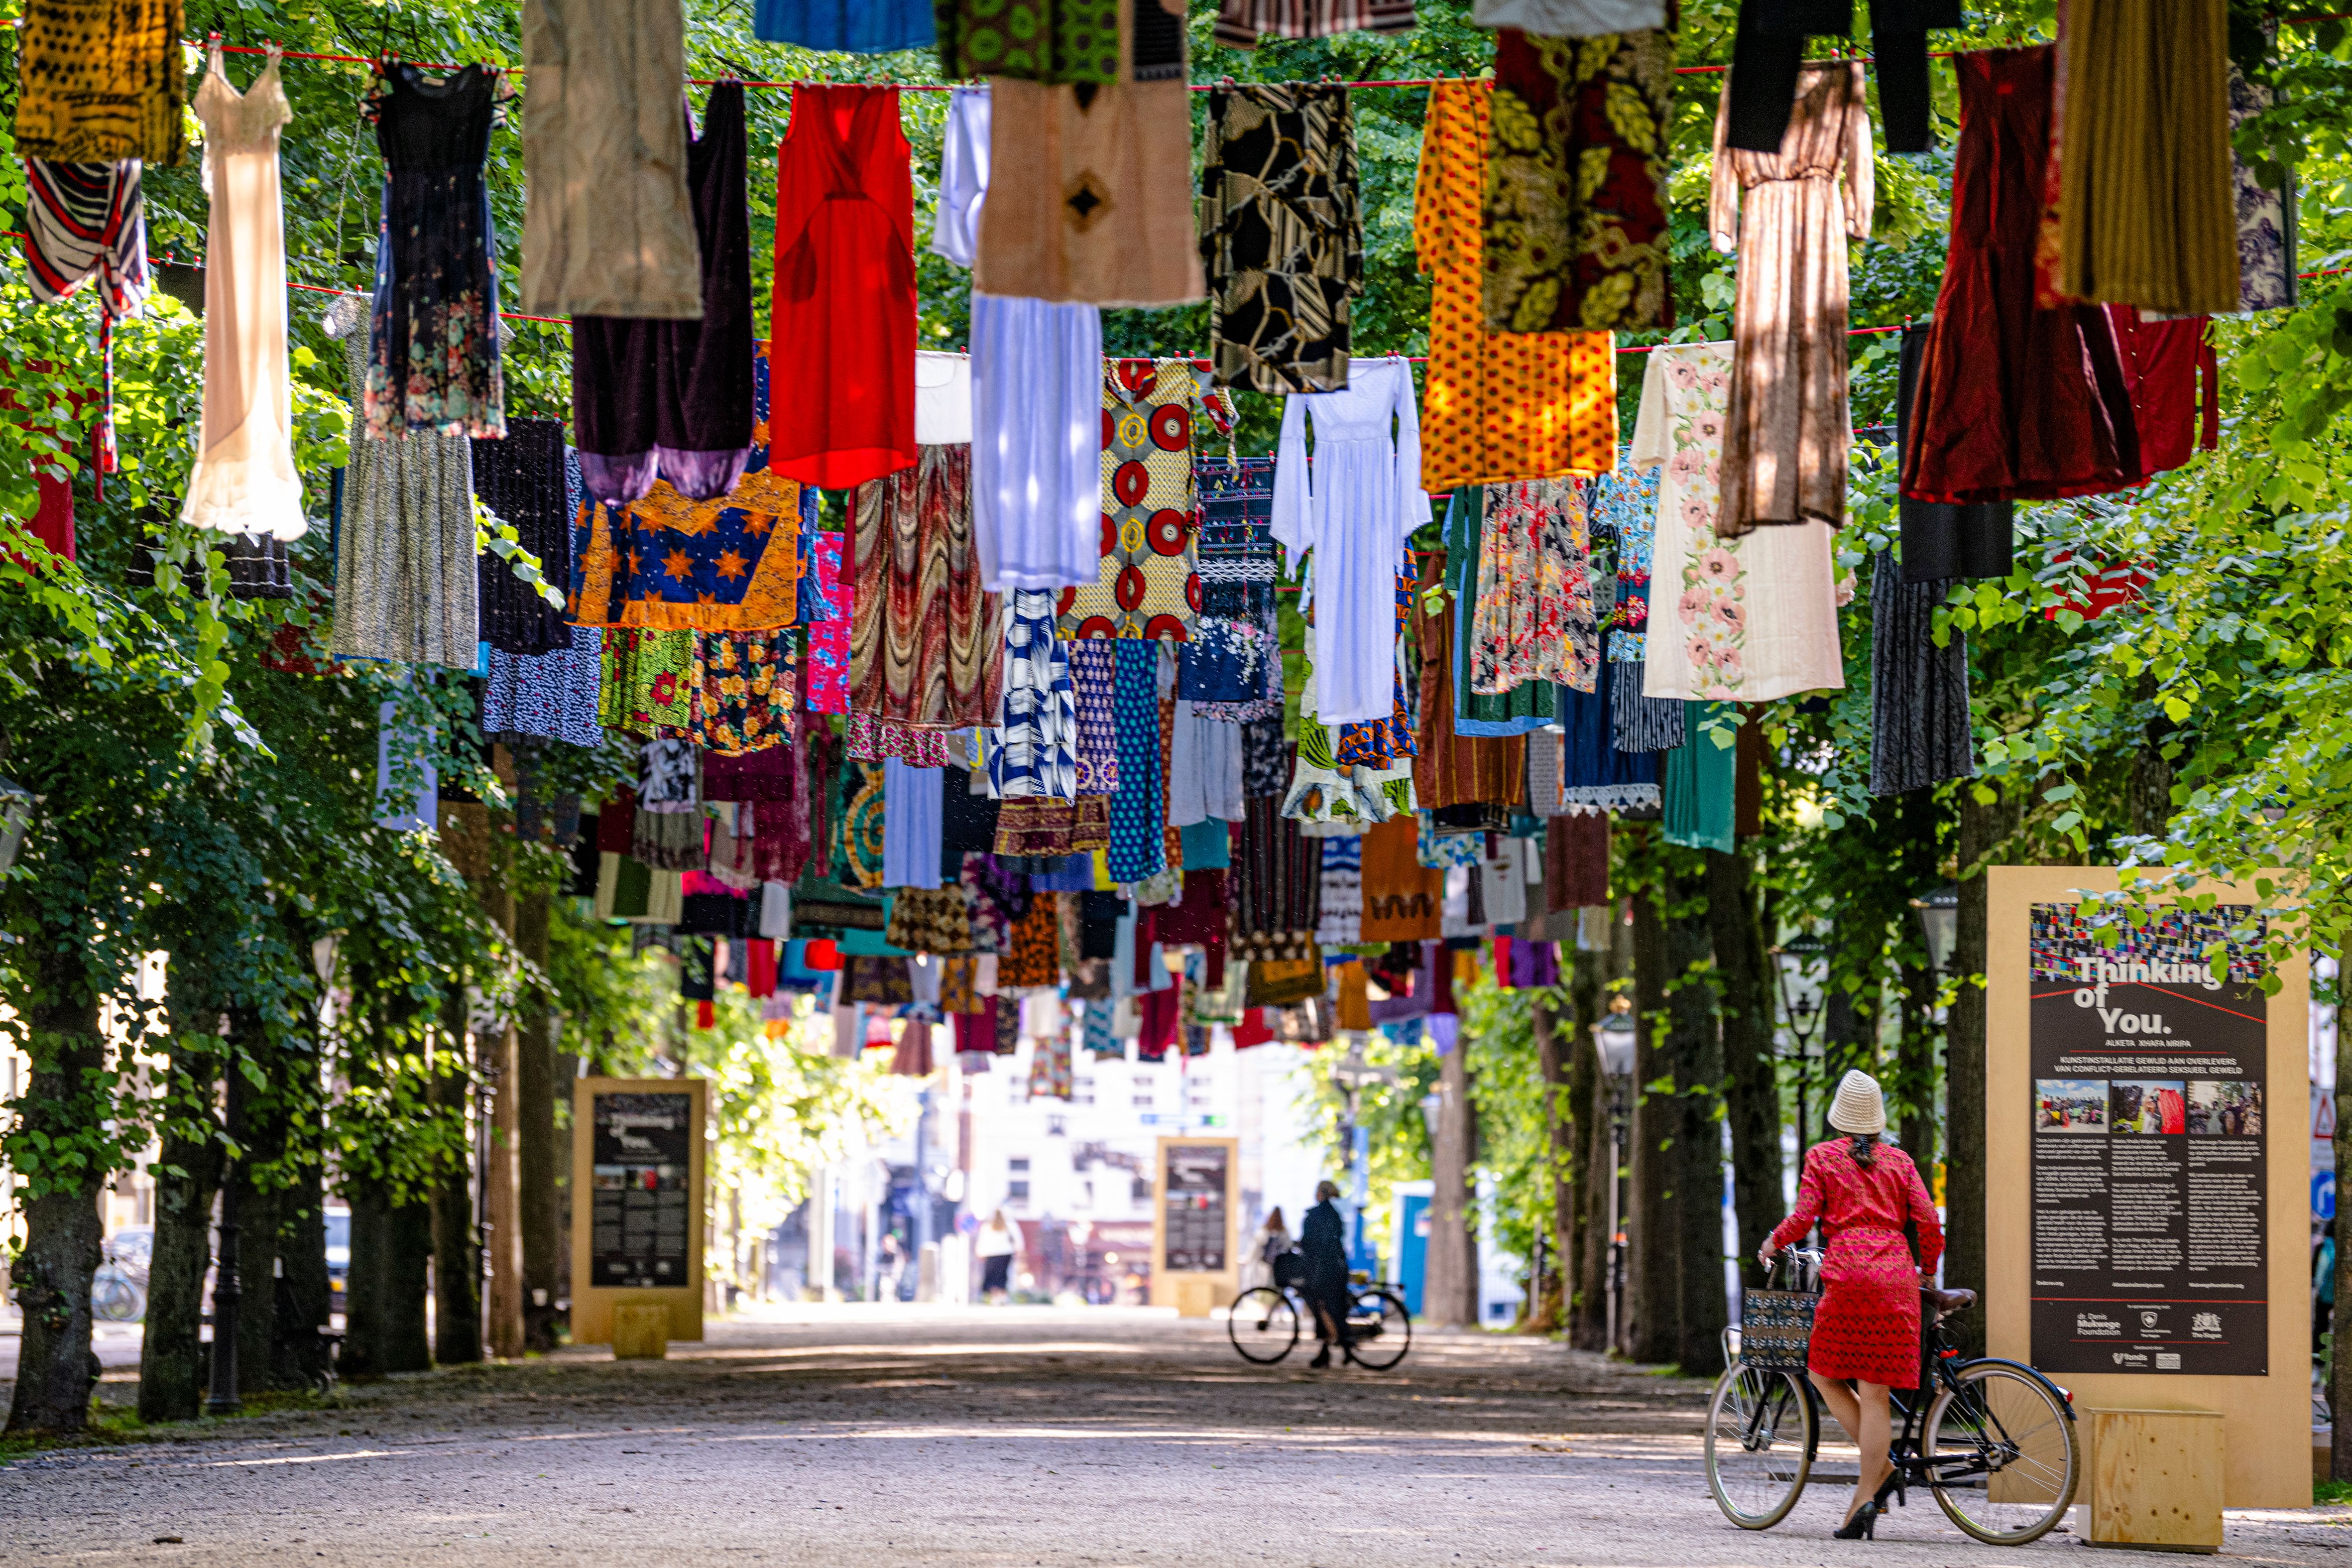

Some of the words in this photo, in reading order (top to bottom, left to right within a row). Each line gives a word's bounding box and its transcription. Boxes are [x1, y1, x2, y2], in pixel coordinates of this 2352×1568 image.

[2074, 956, 2223, 990] Thinking
[2074, 982, 2109, 1008] of
[2097, 1008, 2172, 1034] You.
[2077, 1320, 2121, 1329] Mukwege
